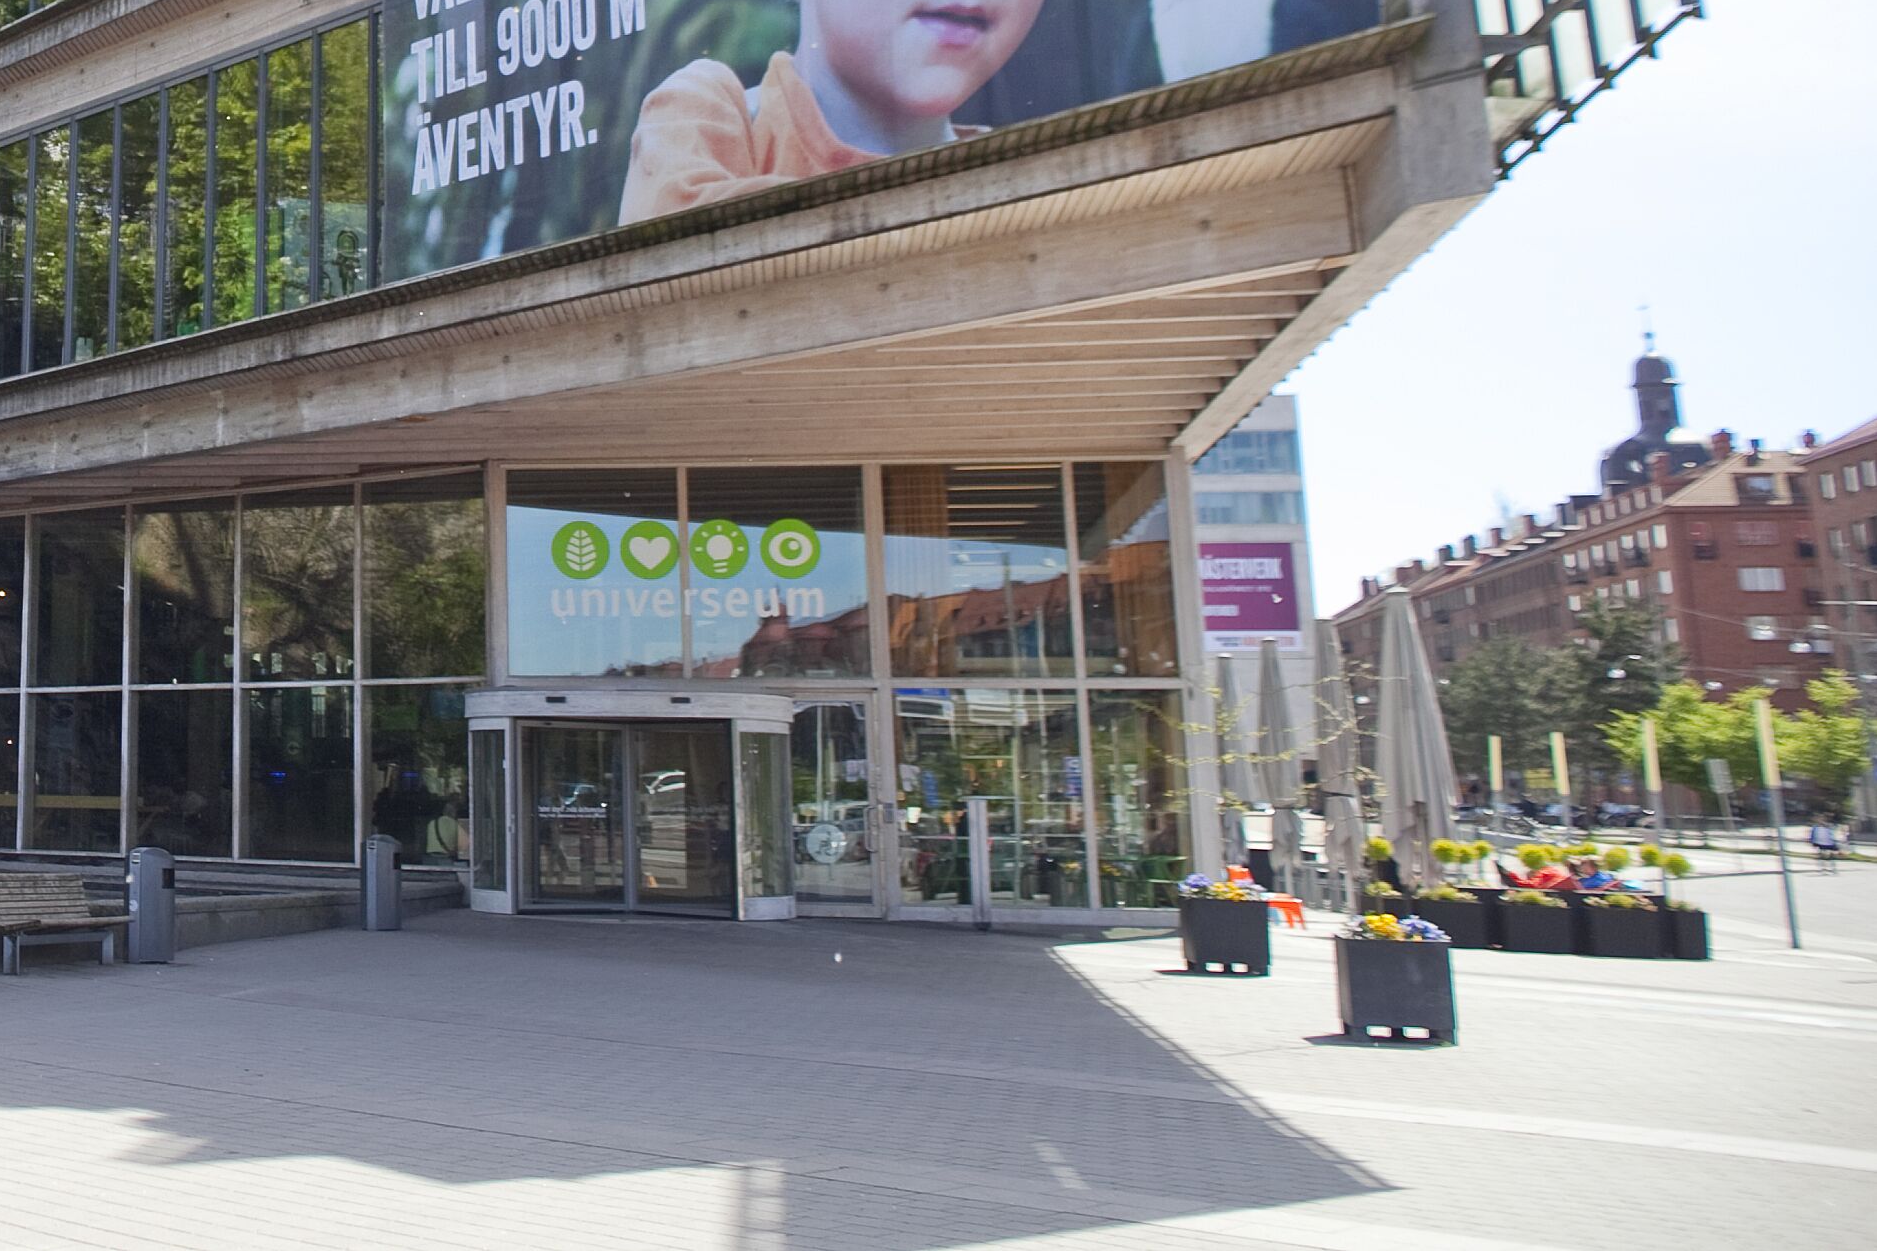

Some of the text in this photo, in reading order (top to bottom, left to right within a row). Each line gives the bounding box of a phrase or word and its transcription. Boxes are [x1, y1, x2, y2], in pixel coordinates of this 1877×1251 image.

[411, 20, 487, 104] TILL
[411, 80, 598, 195] ÄVENTYR.
[551, 586, 825, 617] universeum
